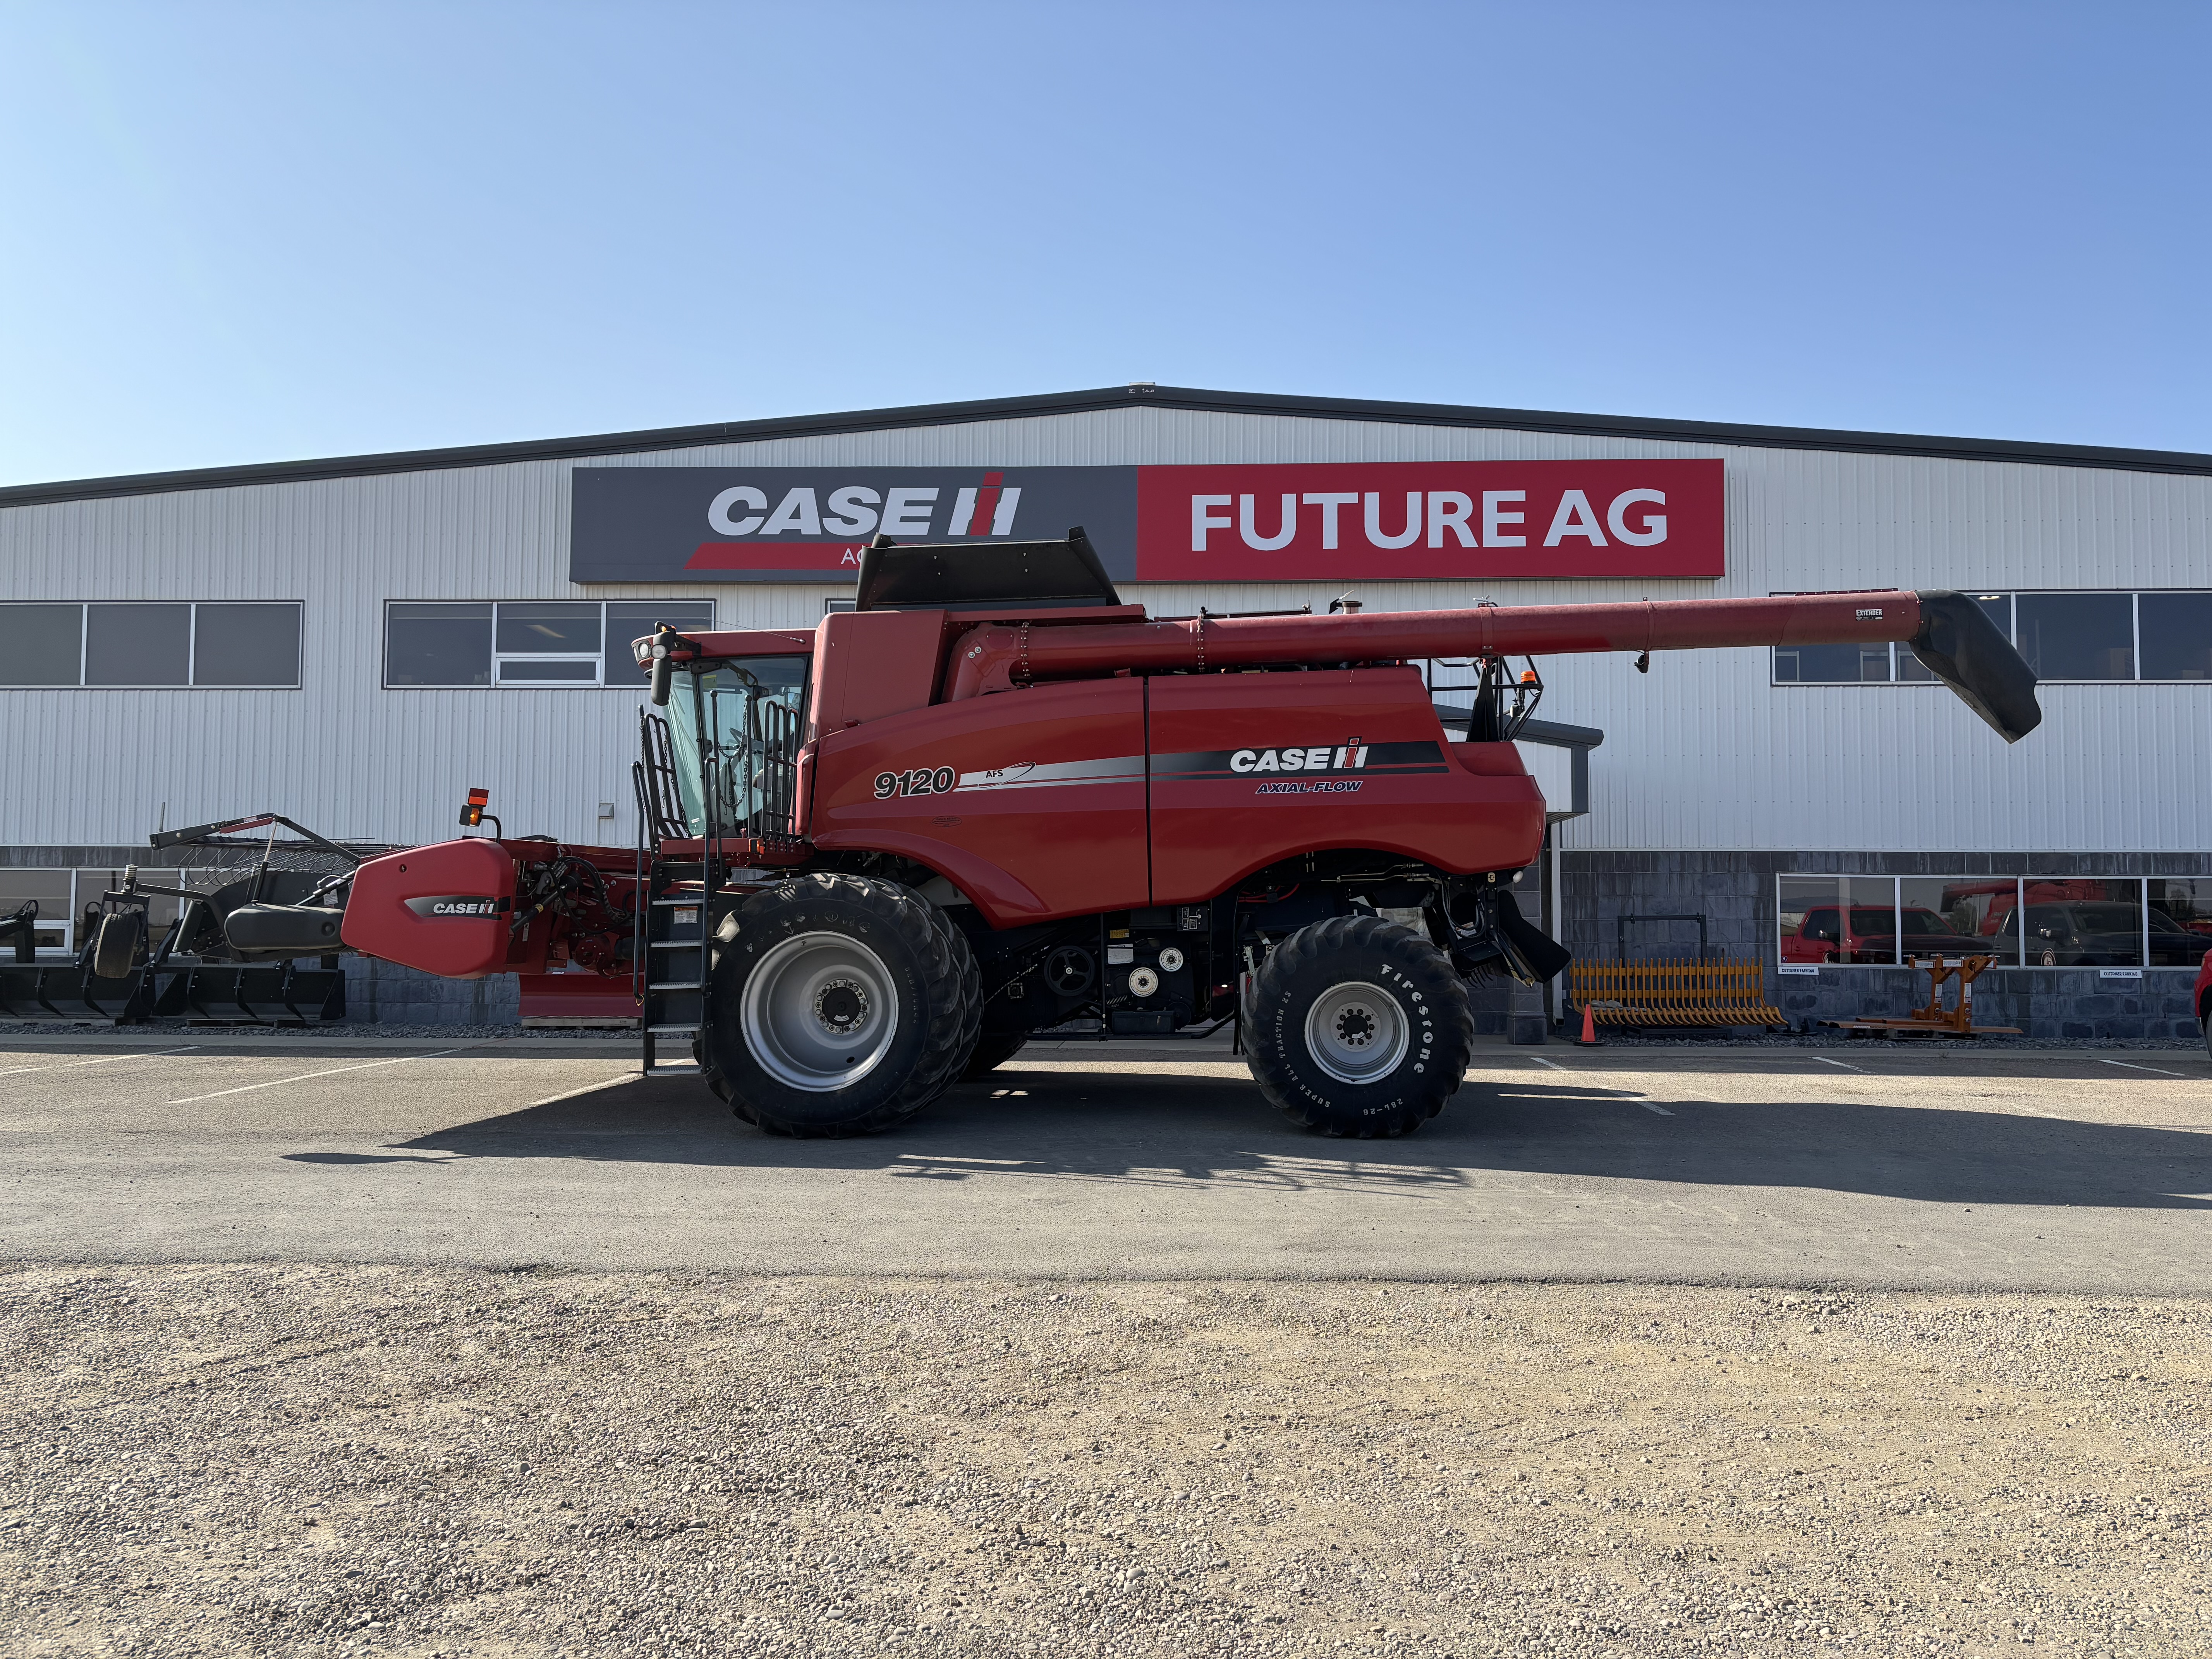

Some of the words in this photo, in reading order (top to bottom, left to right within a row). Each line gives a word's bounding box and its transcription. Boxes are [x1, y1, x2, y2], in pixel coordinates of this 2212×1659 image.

[708, 486, 939, 536] CASE
[947, 471, 1022, 536] IH
[1191, 490, 1526, 551] FUTURE
[1542, 488, 1668, 547] AG
[1230, 748, 1331, 773] CASE
[1333, 738, 1368, 769] IH
[874, 766, 955, 799] 9120
[986, 770, 1003, 778] AFS
[1255, 781, 1363, 794] AXIAL-FLOW
[433, 903, 478, 914] CASE
[478, 900, 494, 914] IH
[1381, 963, 1433, 1073] Firestone
[1275, 1008, 1286, 1058] TRACTION
[1285, 1064, 1298, 1081] ALL
[1300, 1084, 1331, 1108] SUPER
[1363, 1097, 1403, 1115] 28L-26
